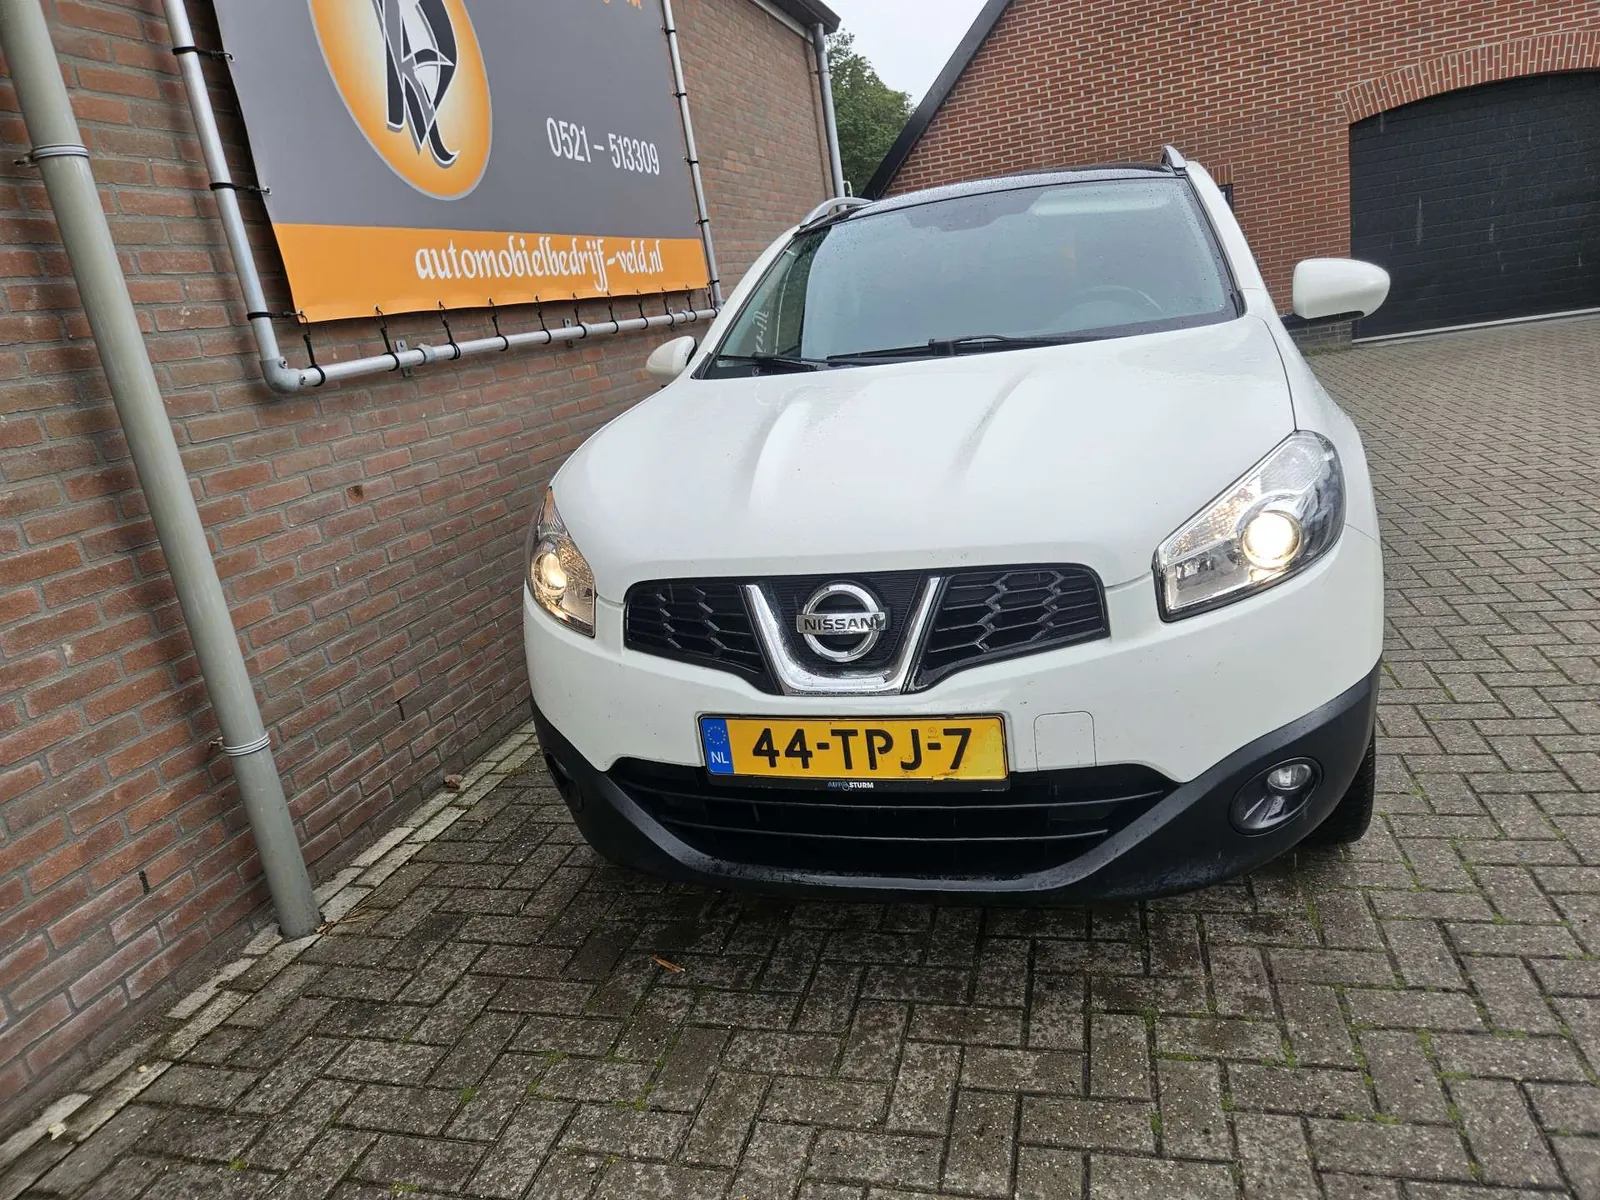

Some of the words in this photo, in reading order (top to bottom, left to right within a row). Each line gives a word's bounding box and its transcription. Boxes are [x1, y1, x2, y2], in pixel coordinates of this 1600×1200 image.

[546, 117, 592, 163] 0521
[608, 132, 660, 175] 513309
[414, 235, 664, 292] automobielbedrijf-veld.nl
[804, 616, 875, 631] NISSAN
[710, 751, 730, 764] NL
[752, 727, 972, 771] 44-TPJ-7
